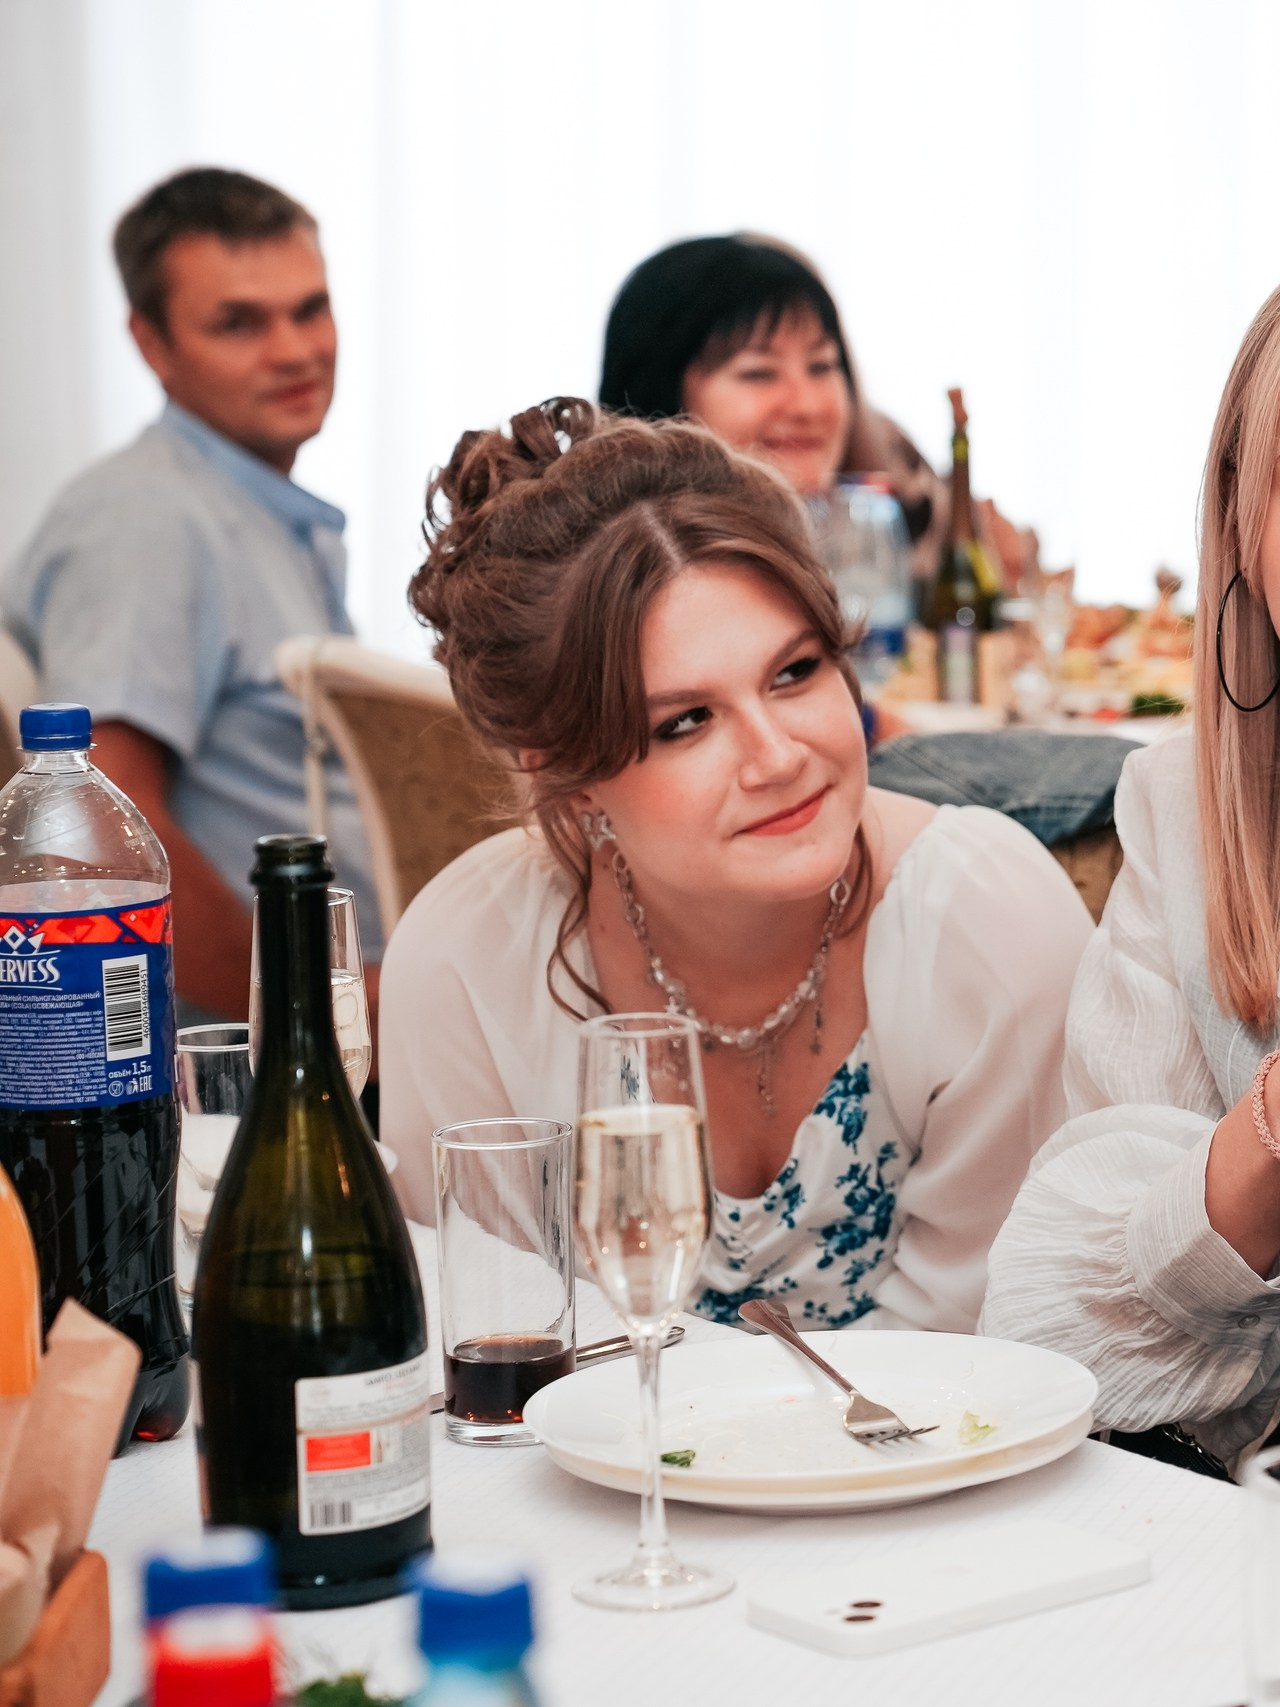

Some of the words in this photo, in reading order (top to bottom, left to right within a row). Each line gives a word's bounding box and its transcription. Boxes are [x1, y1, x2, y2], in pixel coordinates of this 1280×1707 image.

[0, 957, 60, 984] ERVESS
[22, 991, 101, 1002] СИЛЬНОГАЗИРОВАННЫЙ
[108, 1069, 131, 1079] ОБЪЁМ
